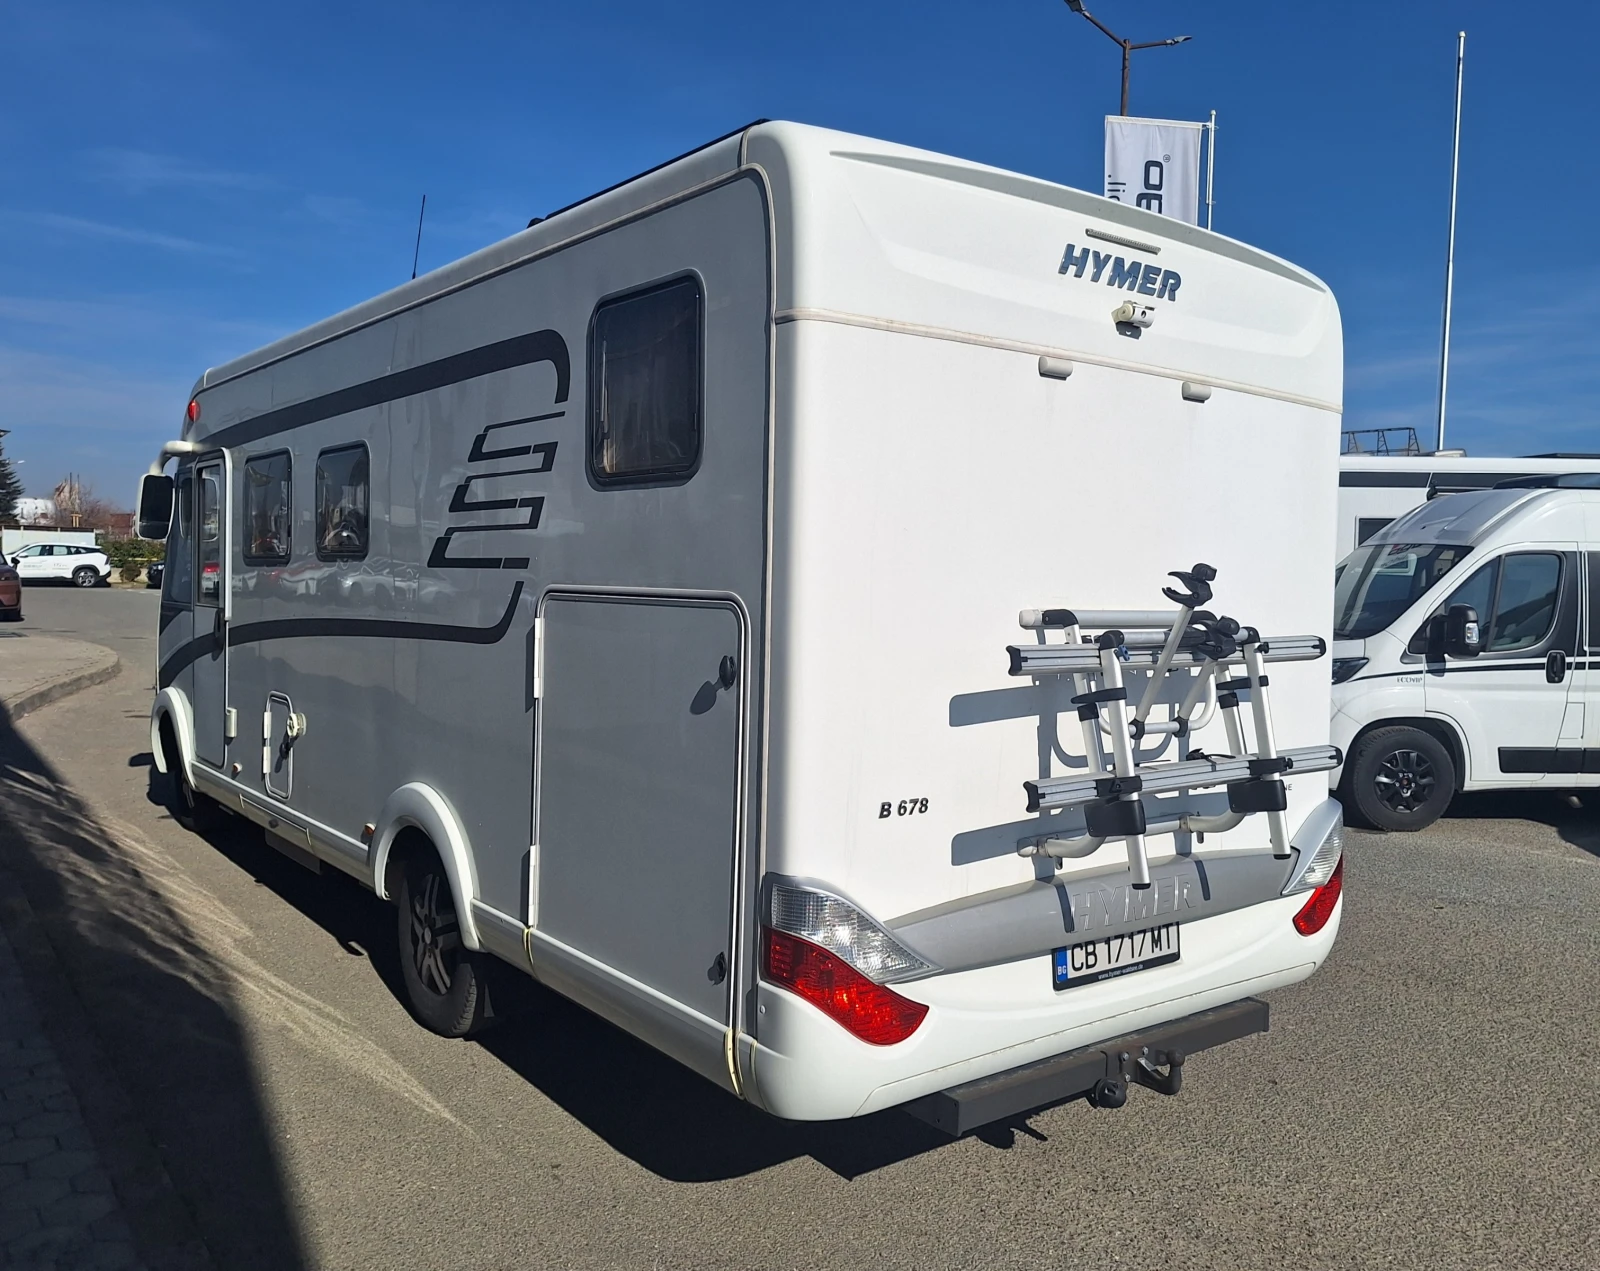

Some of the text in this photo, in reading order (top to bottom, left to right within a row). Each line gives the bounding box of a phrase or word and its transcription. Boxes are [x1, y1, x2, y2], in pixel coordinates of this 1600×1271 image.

[1058, 243, 1182, 302] HYMER
[878, 797, 929, 819] B 678
[1070, 874, 1196, 934] HYMER
[1057, 965, 1067, 976] BG
